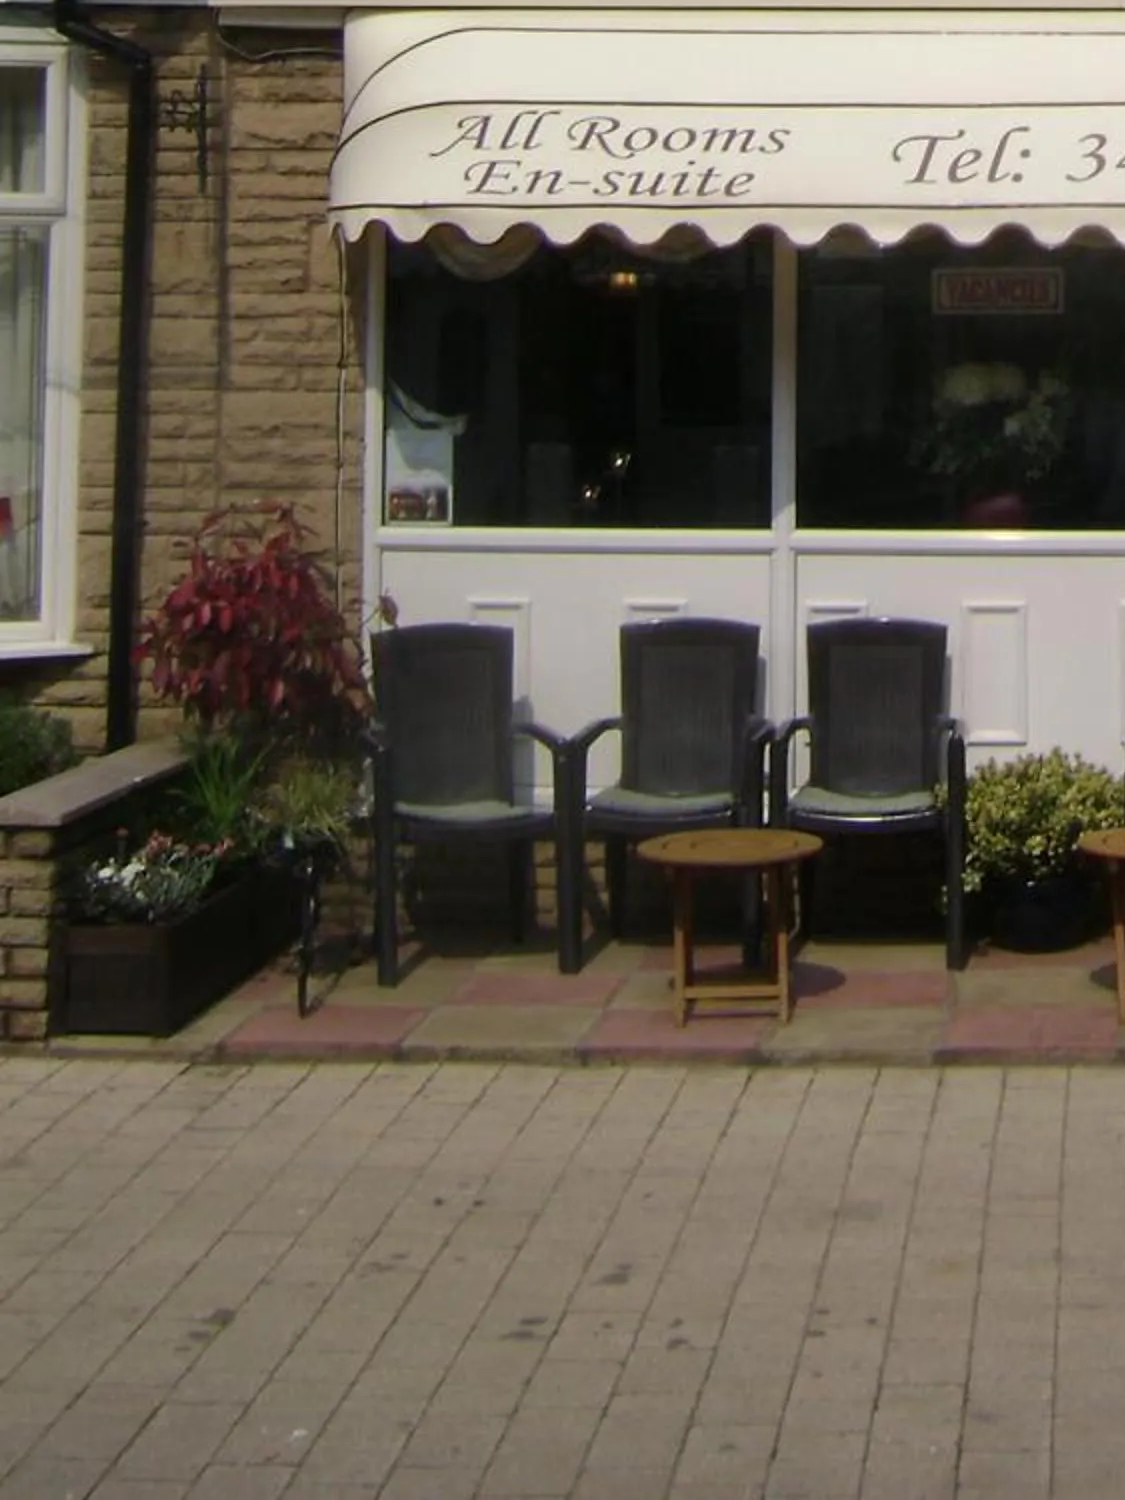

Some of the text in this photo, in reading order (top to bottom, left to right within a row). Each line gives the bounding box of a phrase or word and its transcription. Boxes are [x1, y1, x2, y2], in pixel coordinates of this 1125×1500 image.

[428, 110, 792, 159] All Rooms
[890, 127, 1032, 186] Tel:
[463, 158, 756, 199] En-suite
